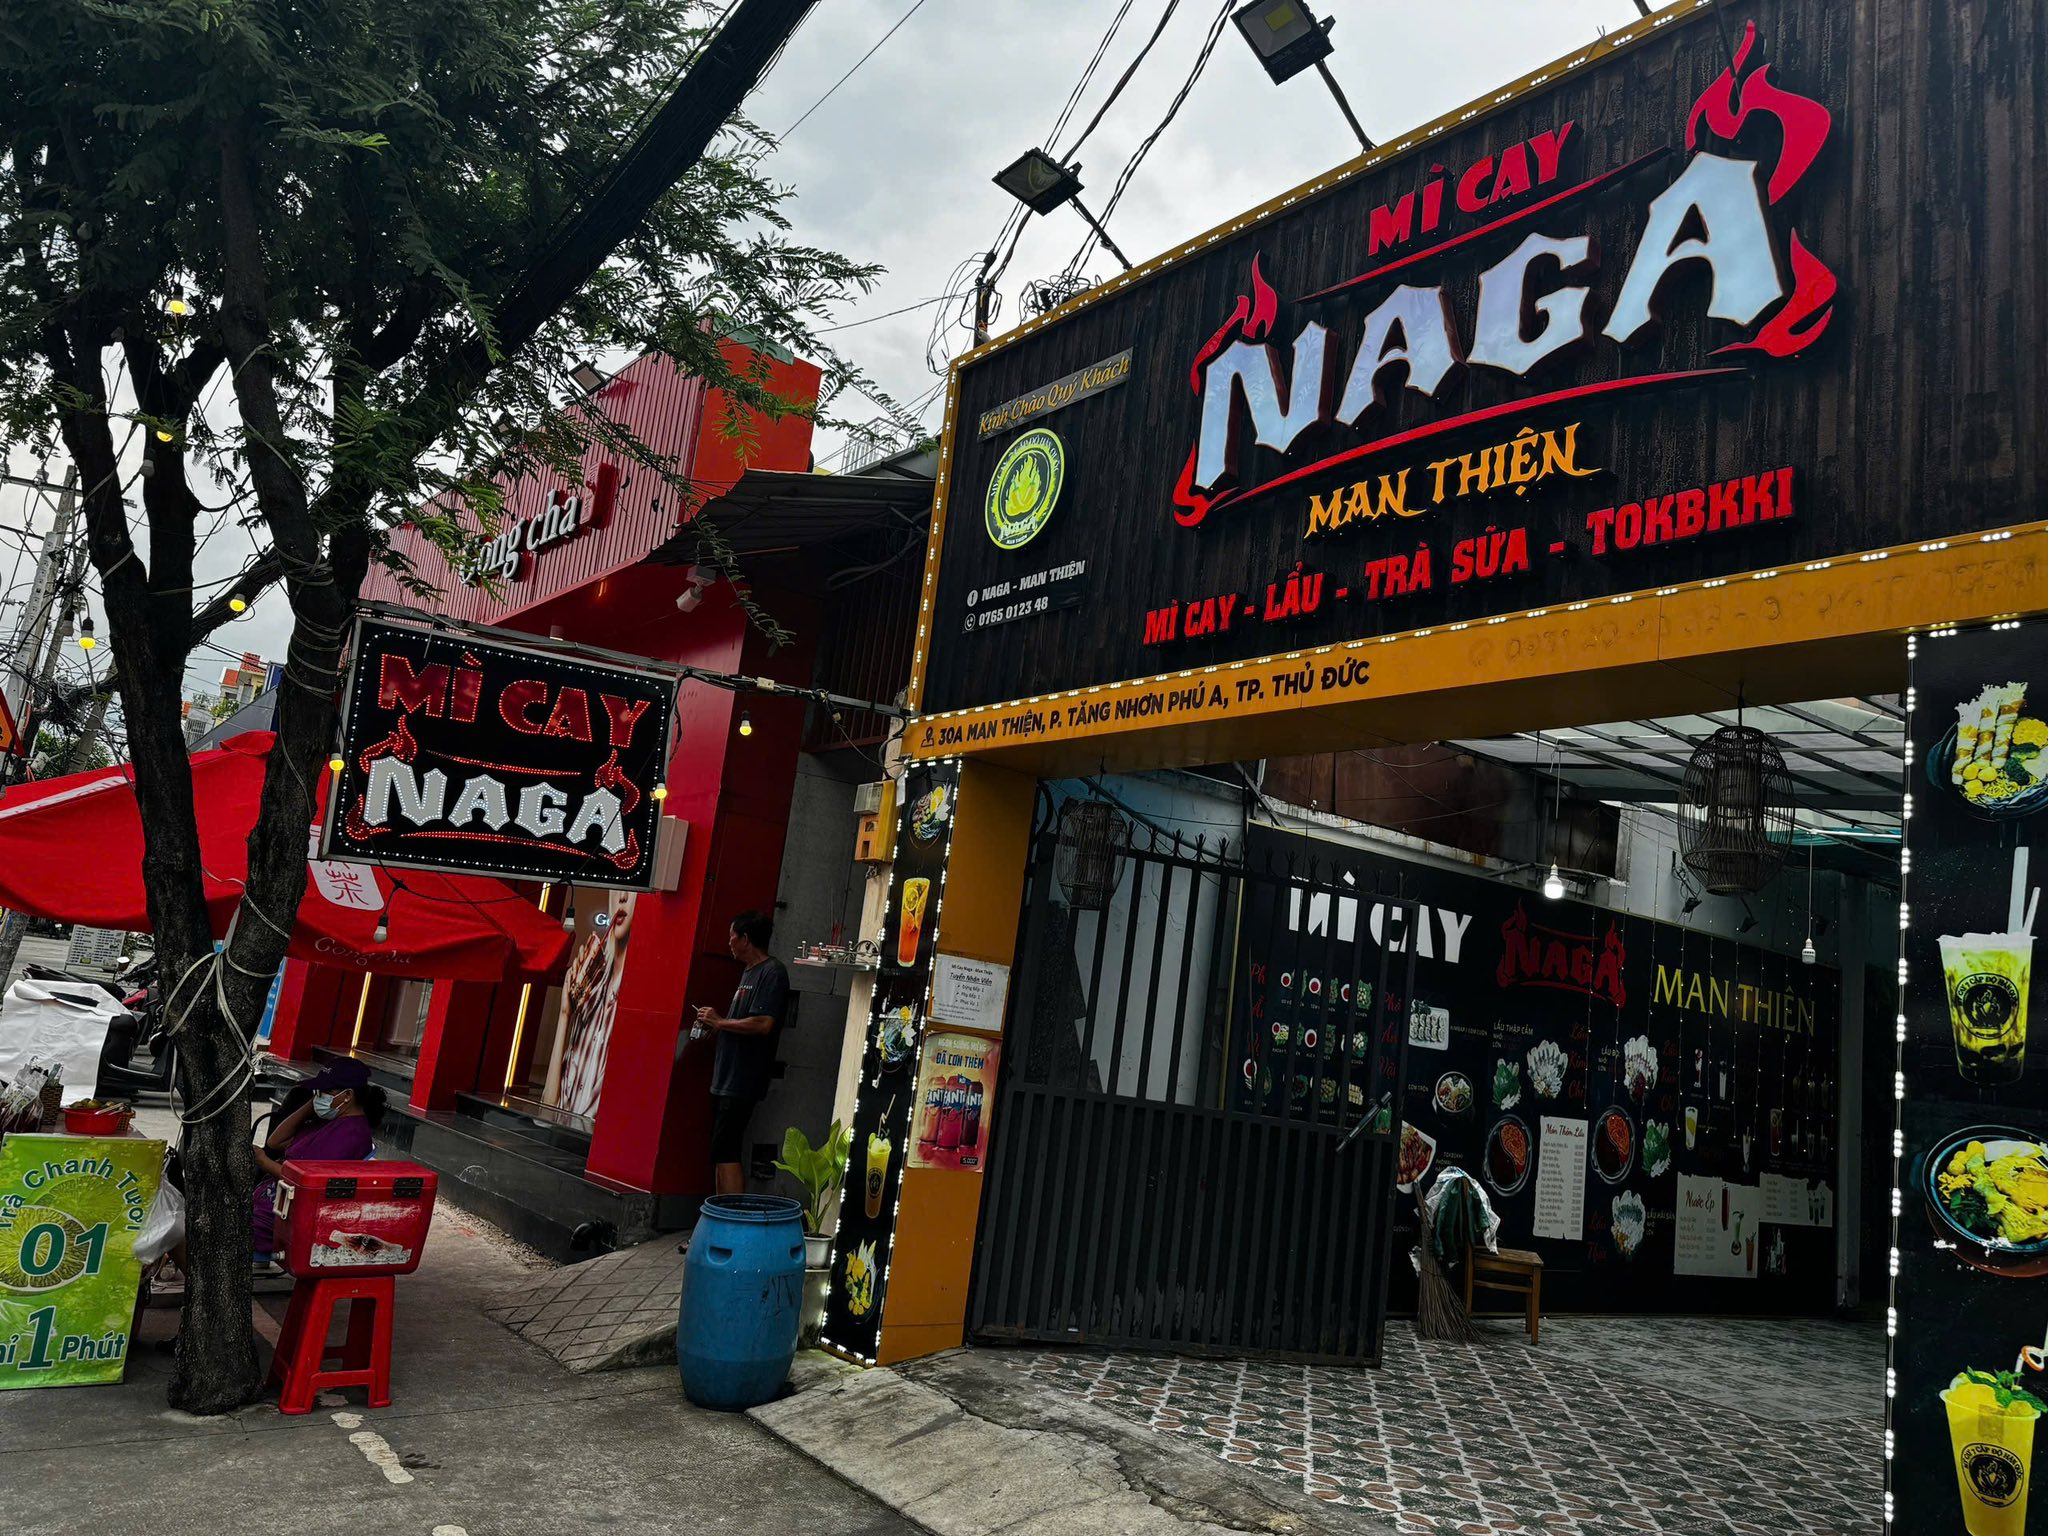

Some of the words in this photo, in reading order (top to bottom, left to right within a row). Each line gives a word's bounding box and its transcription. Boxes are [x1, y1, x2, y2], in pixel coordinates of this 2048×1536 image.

[1367, 163, 1446, 257] MÌ
[1456, 120, 1575, 214] CAY
[1195, 151, 1784, 490] NAGA
[978, 412, 1009, 436] Kính
[1010, 392, 1045, 421] Chào
[1047, 378, 1077, 406] Quý
[1080, 356, 1130, 392] Khách
[526, 488, 581, 551] cha
[1304, 470, 1428, 539] MAN
[1429, 421, 1602, 498] THIỆN
[982, 583, 1010, 602] NAGA
[1019, 571, 1047, 591] MAN
[1050, 560, 1086, 583] THIỆN
[1144, 596, 1178, 646] MÌ
[1184, 594, 1236, 637] CAY
[1263, 560, 1325, 622] LẨU
[1364, 542, 1432, 601] TRÀ
[1451, 525, 1530, 580] SỮA
[1586, 466, 1794, 556] TOKBKKI
[979, 609, 1004, 627] 0765
[1006, 603, 1032, 622] 0123
[1034, 596, 1049, 612] 48
[377, 651, 484, 724] MÌ
[498, 679, 651, 748] CAY
[938, 727, 964, 746] 30A
[967, 720, 999, 742] MAN
[1001, 708, 1046, 738] THIỆN,
[1049, 710, 1062, 730] P.
[1067, 698, 1111, 728] TĂNG
[1114, 696, 1165, 721] NHƠN
[1167, 681, 1206, 715] PHÚ
[1208, 688, 1229, 709] A,
[1236, 680, 1264, 702] TP.
[1272, 661, 1315, 698] THỦ
[1320, 660, 1371, 691] ĐỨC
[363, 755, 626, 855] NAGA
[1369, 902, 1473, 964] CAY
[1504, 929, 1620, 998] NAGA
[1653, 963, 1730, 1019] MAN
[1737, 983, 1816, 1042] THIỆN
[23, 1157, 116, 1190] Chanh
[19, 1221, 109, 1277] 01
[18, 1305, 56, 1371] 1
[59, 1330, 128, 1362] Phút
